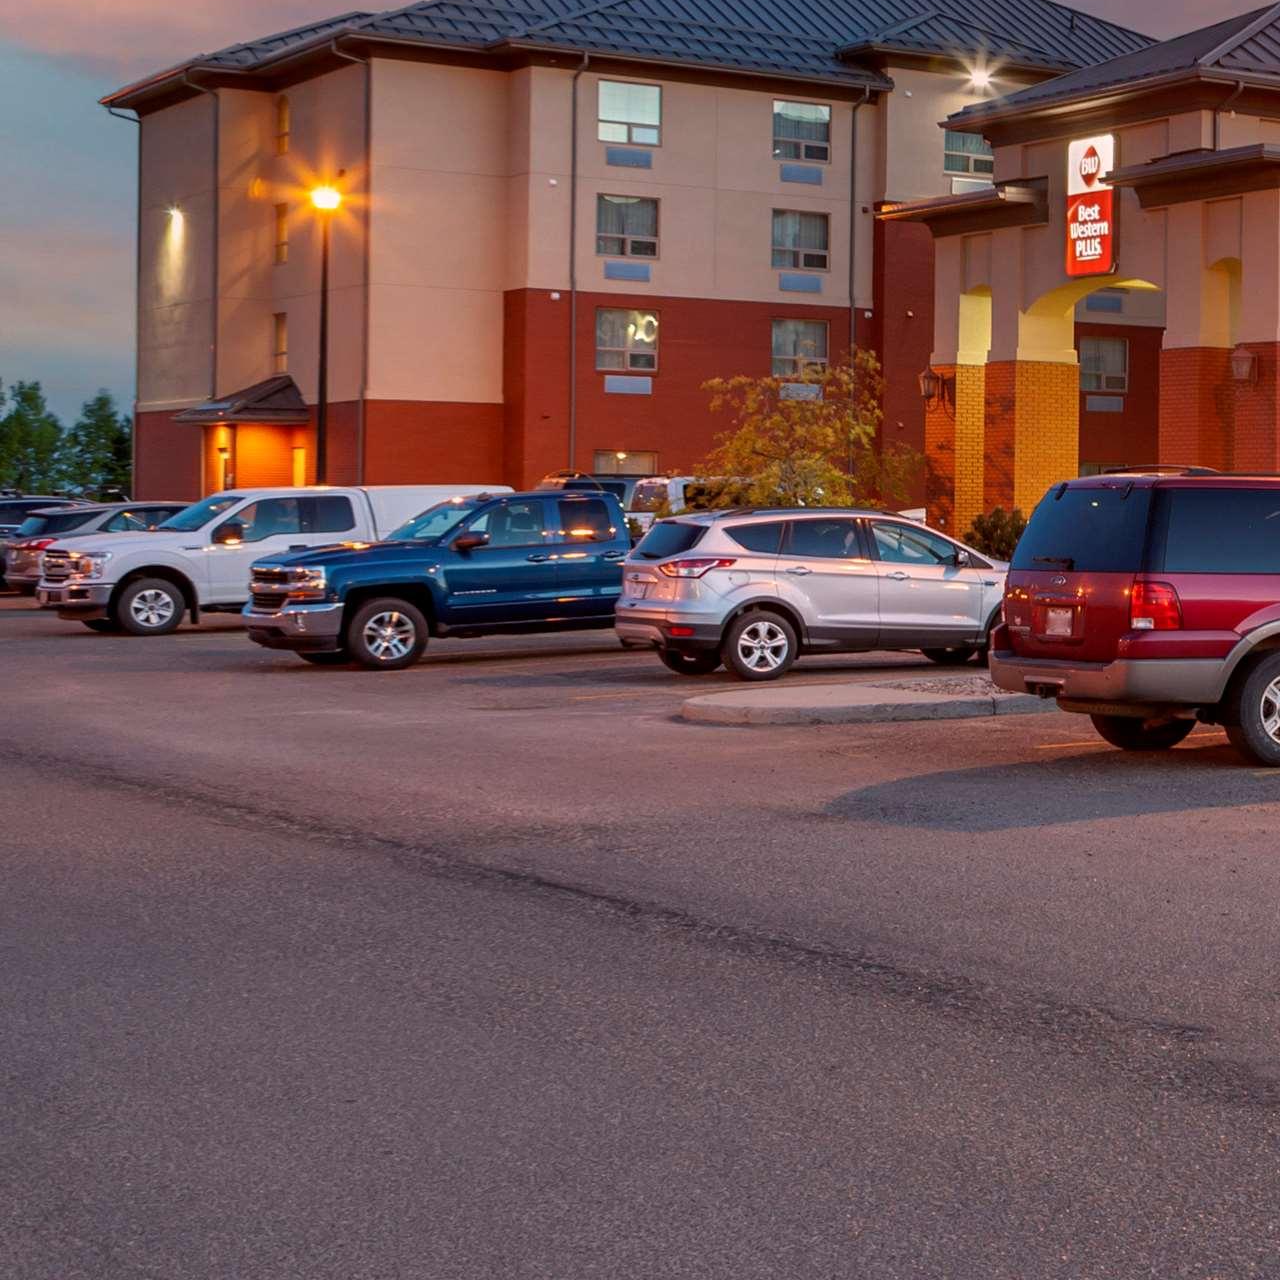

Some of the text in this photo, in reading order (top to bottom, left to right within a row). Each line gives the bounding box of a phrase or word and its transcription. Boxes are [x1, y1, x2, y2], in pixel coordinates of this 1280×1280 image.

[1081, 156, 1098, 176] BW
[1078, 204, 1101, 221] Best
[1070, 221, 1109, 239] Western
[1075, 238, 1102, 257] PLUS
